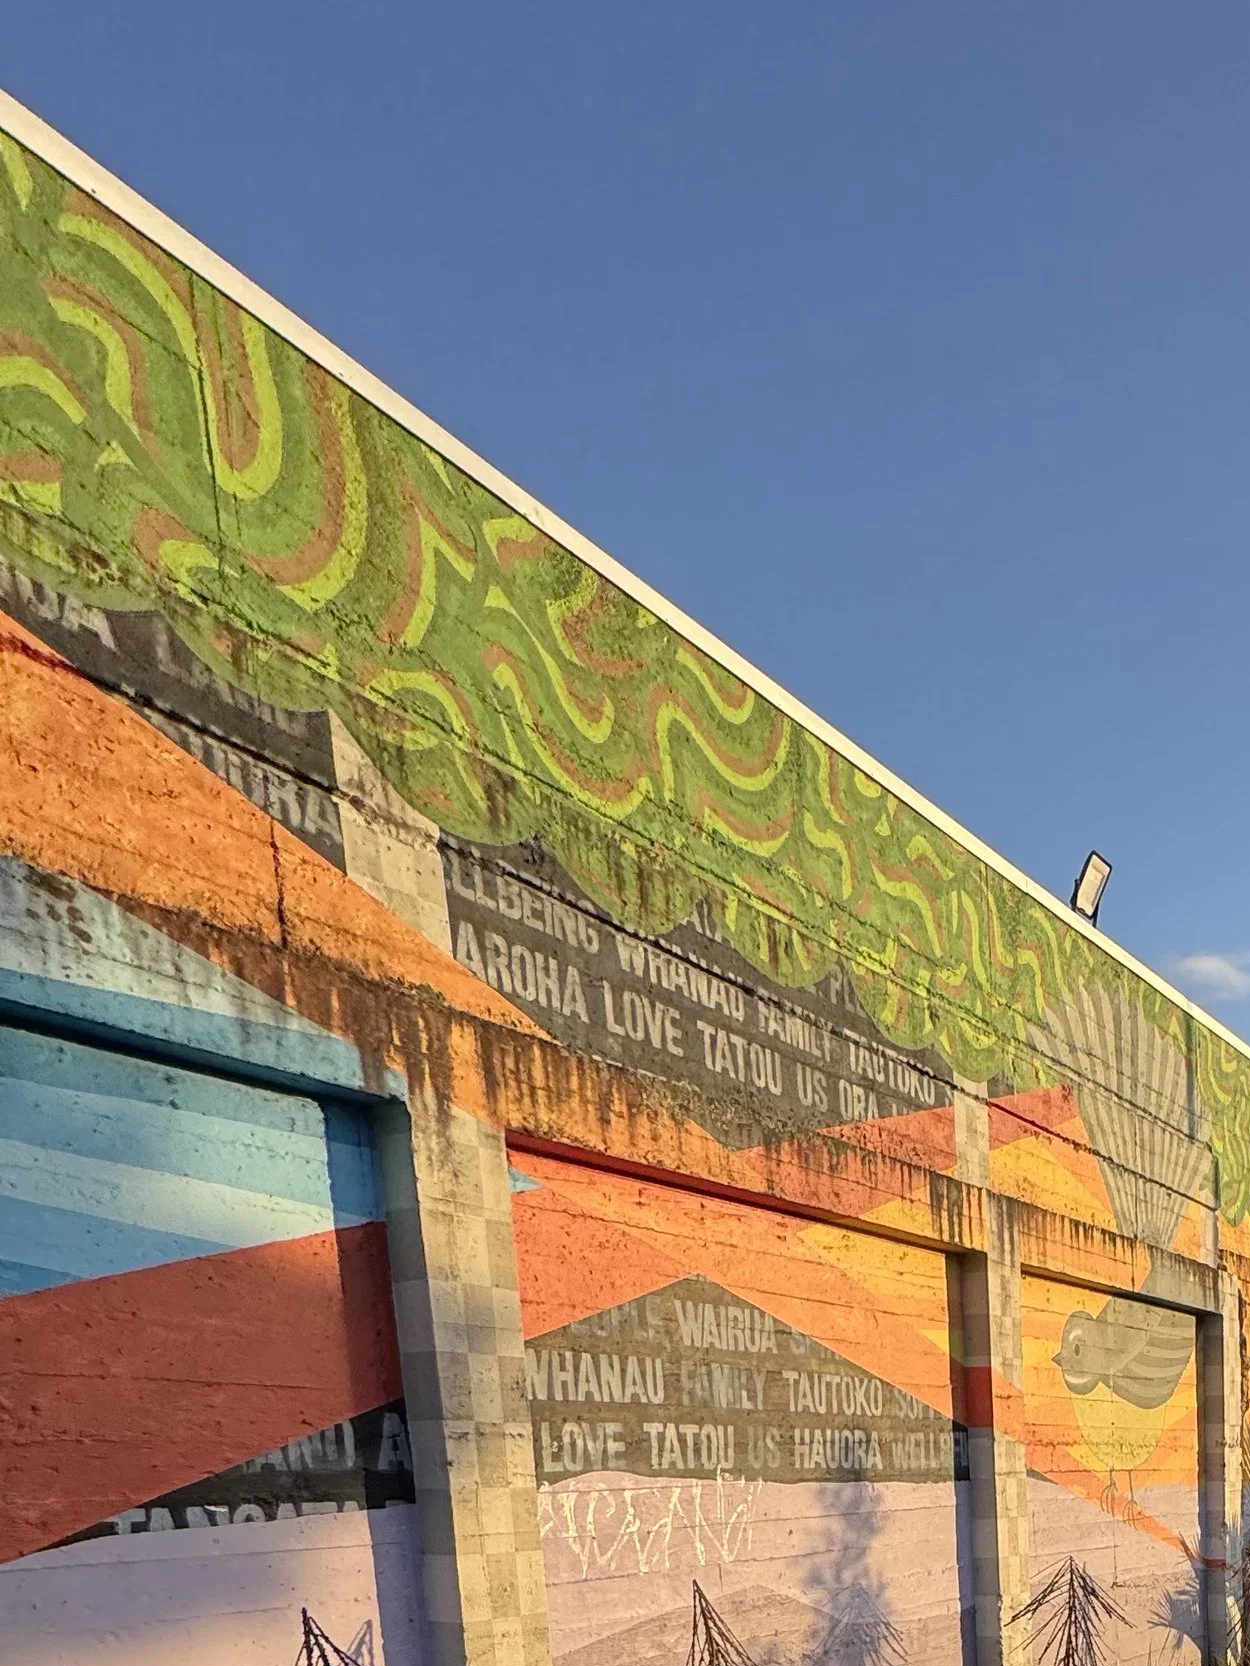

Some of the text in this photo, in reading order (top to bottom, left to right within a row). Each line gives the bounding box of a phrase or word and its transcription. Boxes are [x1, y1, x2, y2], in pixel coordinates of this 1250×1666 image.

[456, 921, 590, 1023] AROHA
[603, 980, 684, 1057] LOVE
[697, 1020, 782, 1096] TATOU
[797, 1062, 828, 1112] US
[839, 1079, 879, 1121] ORA
[606, 921, 744, 1022] WHANAU
[757, 986, 832, 1064] FAMILY
[673, 1298, 778, 1354] WAIRUA
[681, 1360, 767, 1411] FAMILY
[782, 1370, 883, 1417] TAUTOKO
[540, 1421, 627, 1472] LOVE
[643, 1422, 734, 1471] TATOU
[747, 1424, 782, 1469] US
[794, 1428, 883, 1470] HAUORA
